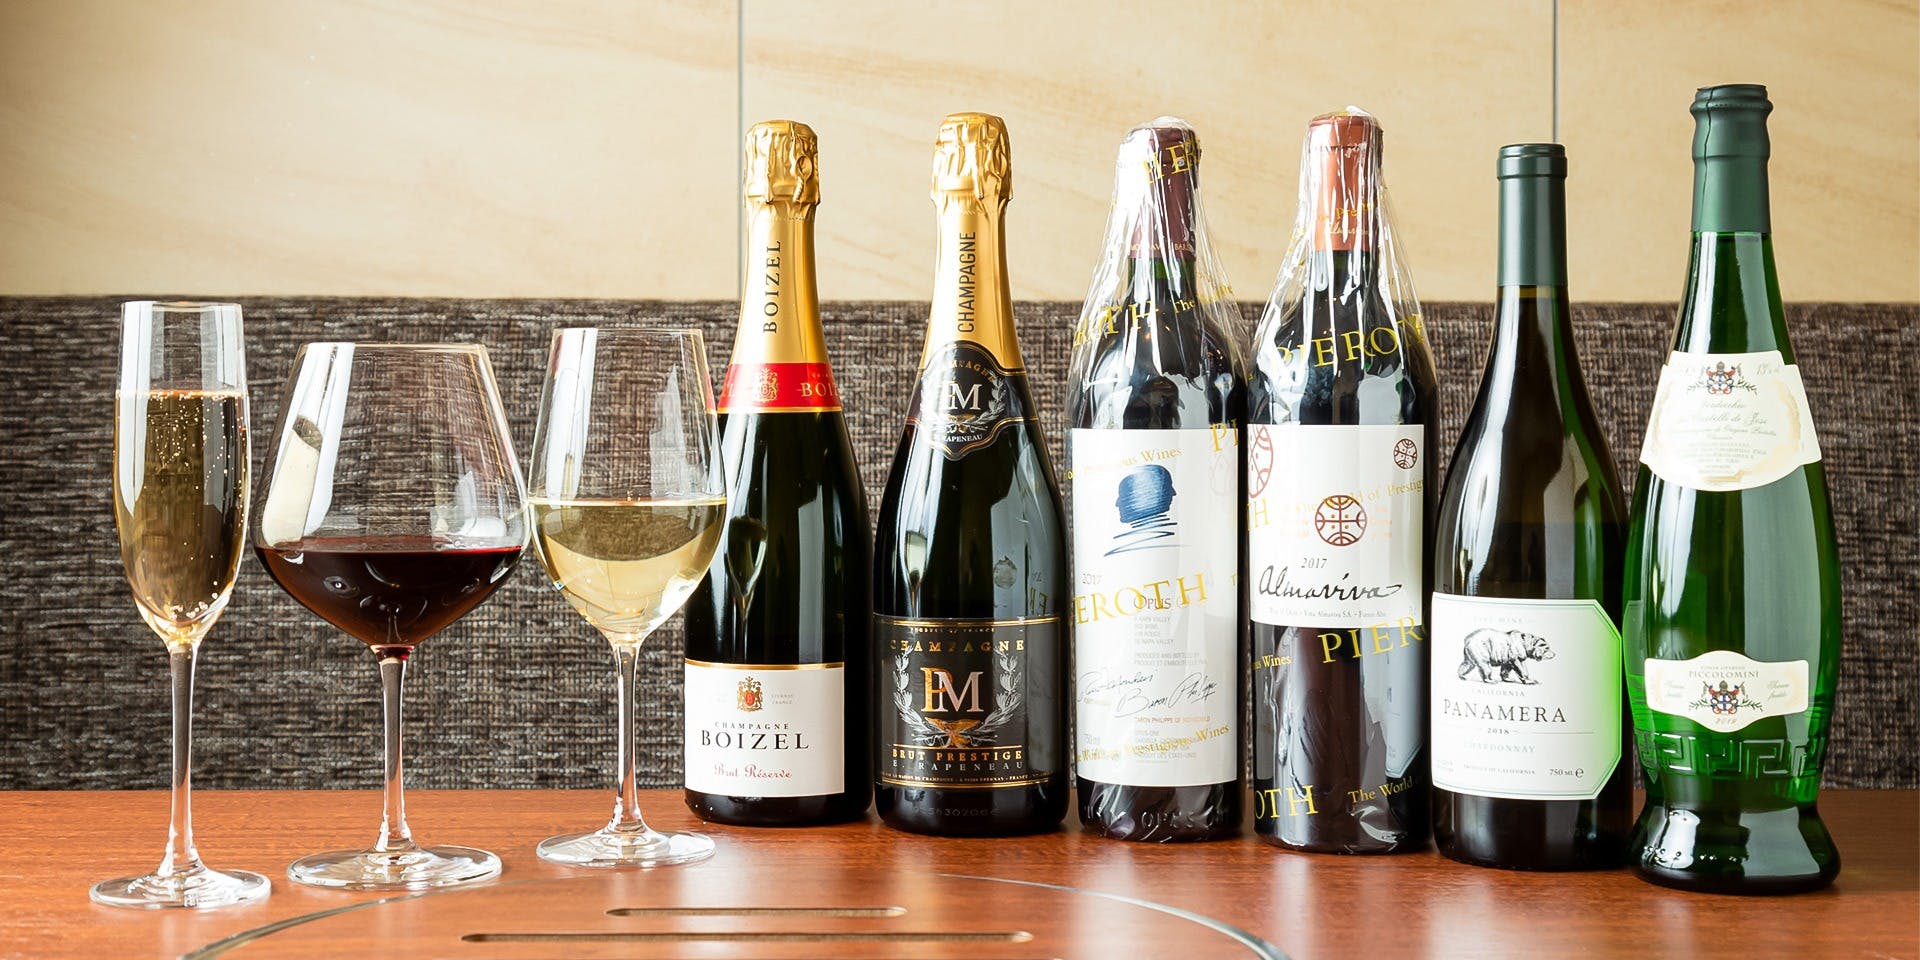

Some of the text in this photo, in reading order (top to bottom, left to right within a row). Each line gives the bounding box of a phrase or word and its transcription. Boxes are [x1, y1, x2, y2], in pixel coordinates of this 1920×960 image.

[763, 241, 782, 334] BOIZEL
[957, 231, 977, 333] CHAMPAGNE
[1141, 447, 1183, 463] Wines
[1301, 557, 1328, 570] 2017
[889, 639, 1025, 653] CHAMPAGNE
[1262, 654, 1292, 668] Wines
[1688, 670, 1760, 679] PICCOLOMINI
[1443, 698, 1567, 723] PANAMERA
[714, 721, 790, 730] CHAMPAGNE
[1487, 727, 1510, 735] 2018
[701, 729, 810, 751] BOIZEL
[1195, 724, 1230, 742] Wines
[892, 748, 1023, 762] BRUT PRESTIGE
[918, 761, 1024, 771] RAPENEAU
[1347, 790, 1376, 805] The
[1378, 776, 1415, 798] World
